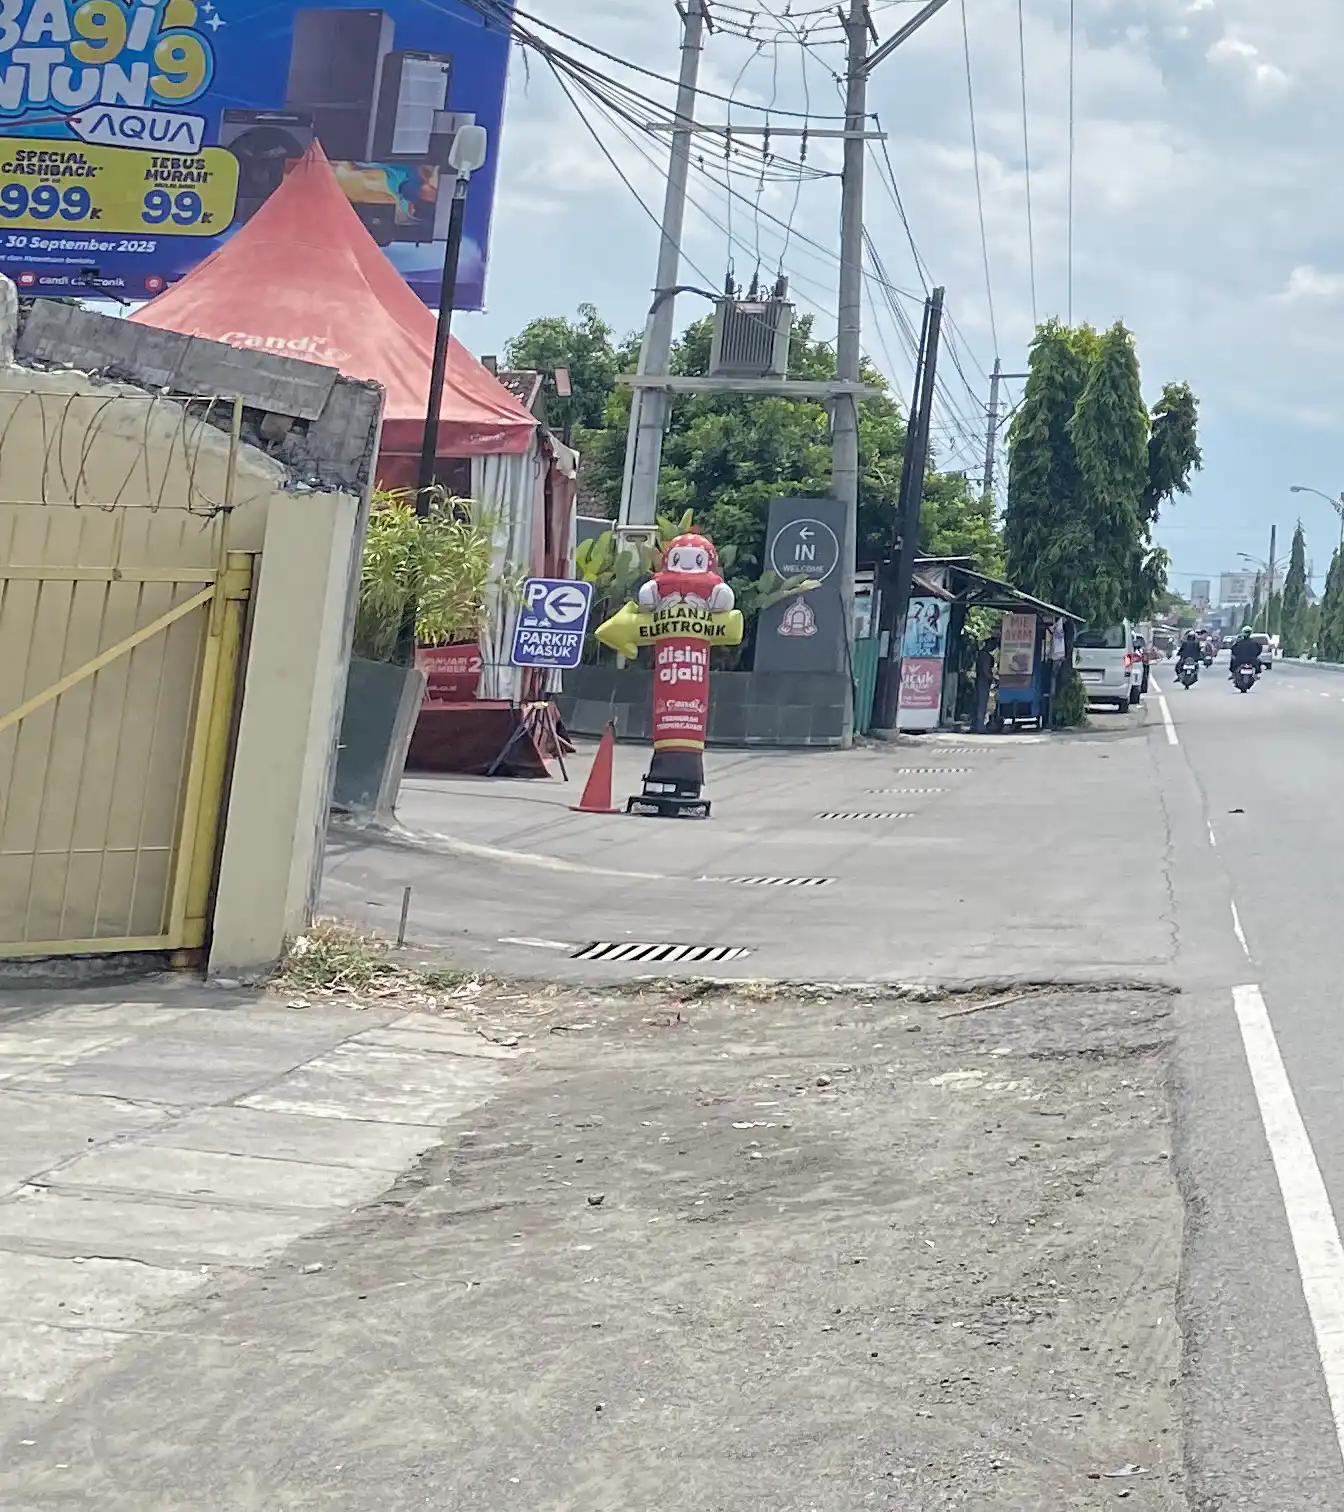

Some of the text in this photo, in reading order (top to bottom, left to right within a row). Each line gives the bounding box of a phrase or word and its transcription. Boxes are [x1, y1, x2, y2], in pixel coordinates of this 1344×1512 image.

[88, 113, 195, 145] AQUA
[15, 150, 88, 165] SPECIAL
[151, 157, 206, 170] TEBUS
[6, 235, 157, 253] 30 September 2025
[794, 543, 816, 561] IN
[783, 564, 825, 573] WELCOME
[527, 583, 549, 612] P
[653, 607, 713, 622] BELANJA
[639, 621, 727, 637] ELEKTRONIK
[519, 631, 578, 647] PARKIR
[522, 644, 572, 658] MASUK
[658, 645, 707, 665] disini
[660, 663, 704, 684] aja!!
